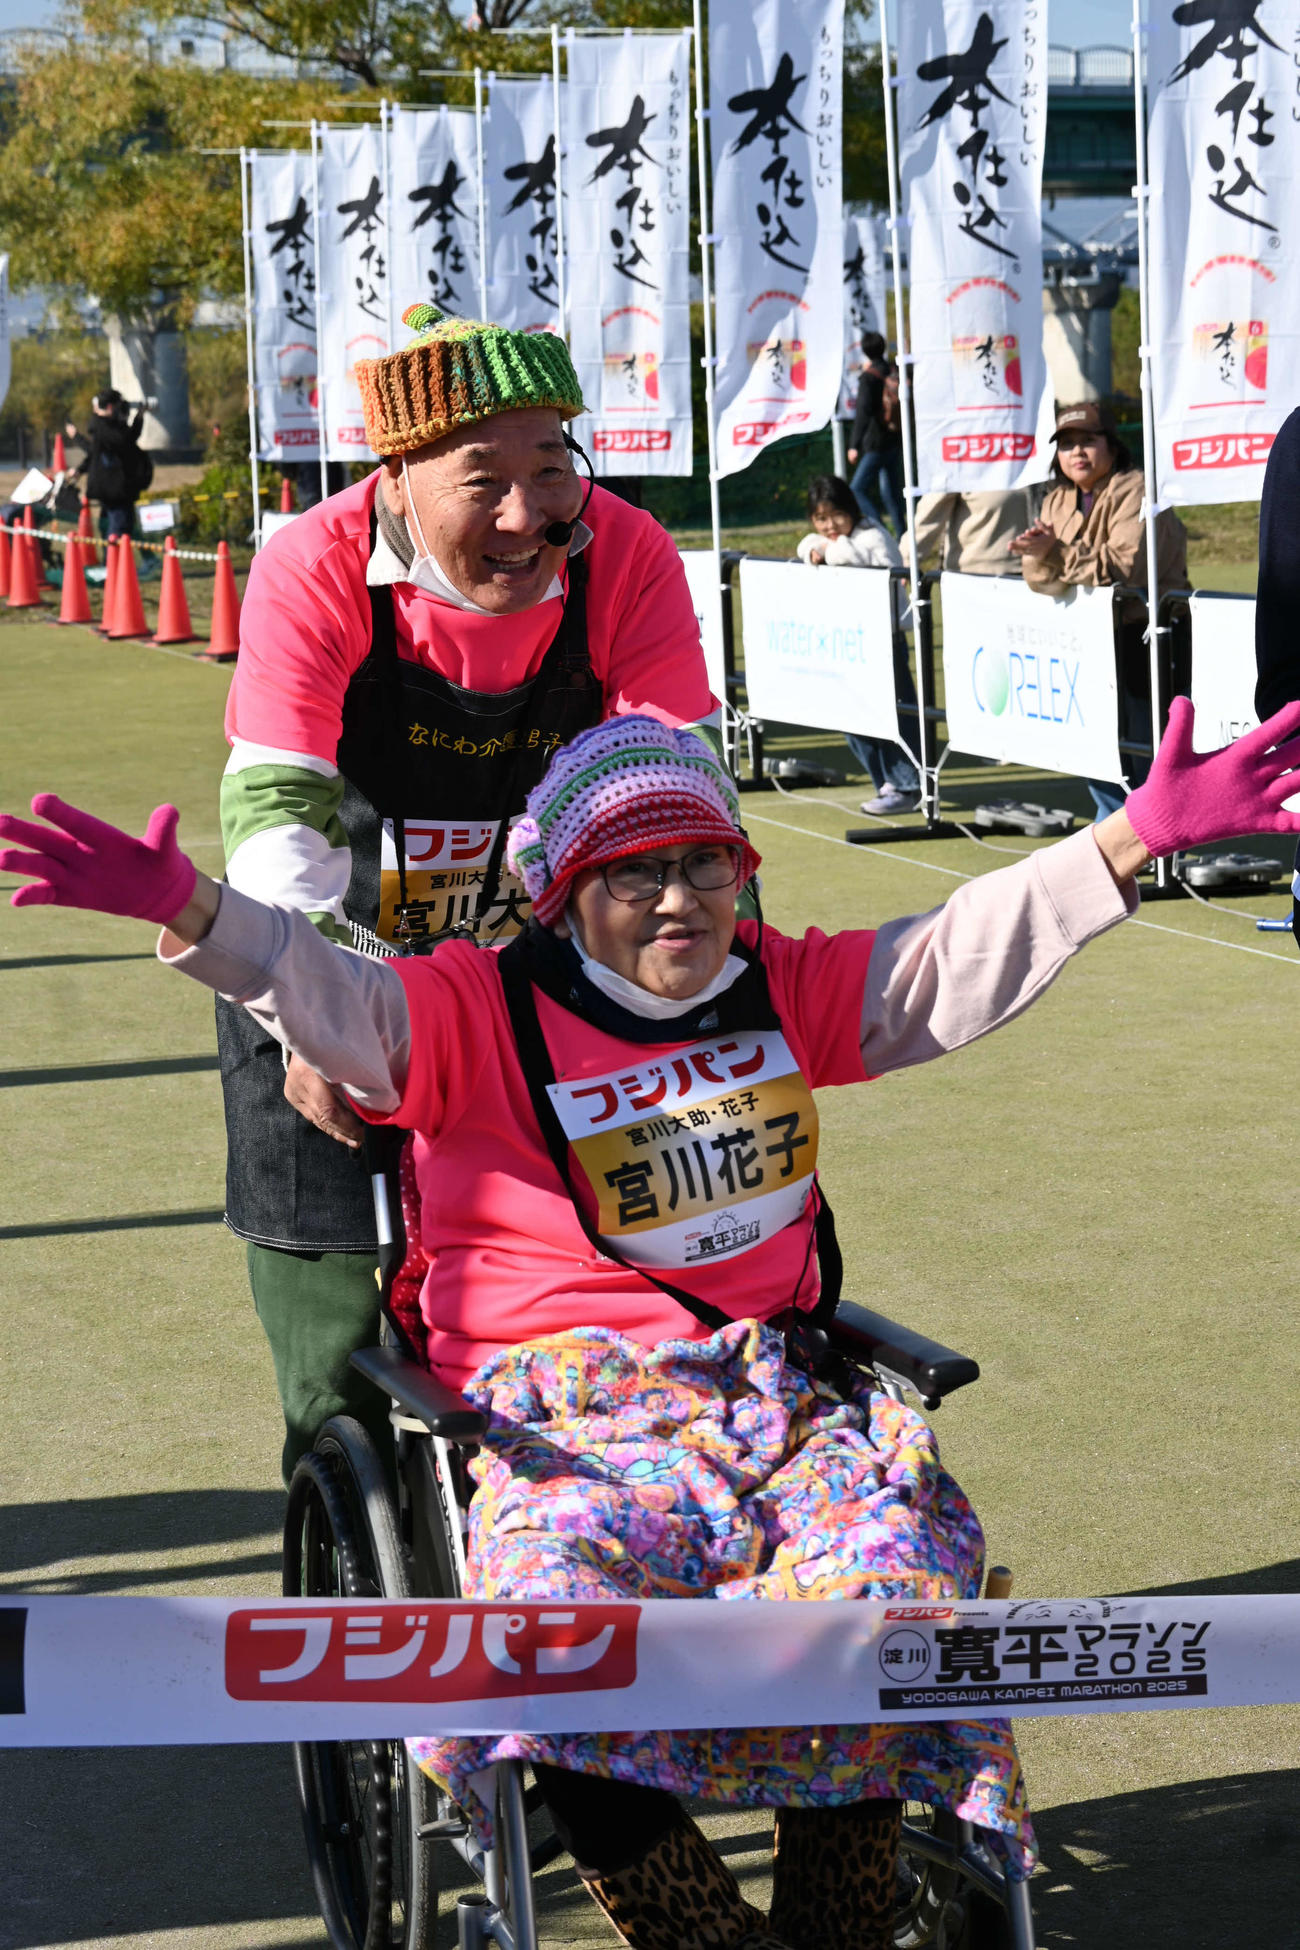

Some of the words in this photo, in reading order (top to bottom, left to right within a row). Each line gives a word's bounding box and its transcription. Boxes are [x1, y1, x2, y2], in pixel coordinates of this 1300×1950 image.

[816, 25, 833, 188] もっちりおいしい
[1020, 0, 1037, 166] っちりおいしい
[728, 52, 812, 274] 本仕込
[914, 12, 1018, 260] 本仕込
[408, 160, 474, 317] 本仕込
[582, 94, 661, 290] 本仕込
[265, 196, 317, 332] 本仕込
[338, 175, 387, 322] 本仕込
[945, 437, 1033, 459] フジパン
[571, 1041, 765, 1124] フジパン
[625, 1091, 759, 1147] 宮川大助・花子
[603, 1111, 808, 1227] 宮川花子
[250, 1613, 615, 1683] フジパン
[884, 1648, 927, 1664] 淀川
[889, 1608, 950, 1619] フジパン
[1074, 1621, 1211, 1650] マラソン
[1074, 1648, 1207, 1677] 2025
[902, 1689, 990, 1704] YODOGAWA
[994, 1687, 1055, 1699] KANPEI
[1060, 1683, 1143, 1697] MARATHON
[1146, 1680, 1188, 1692] 2025
